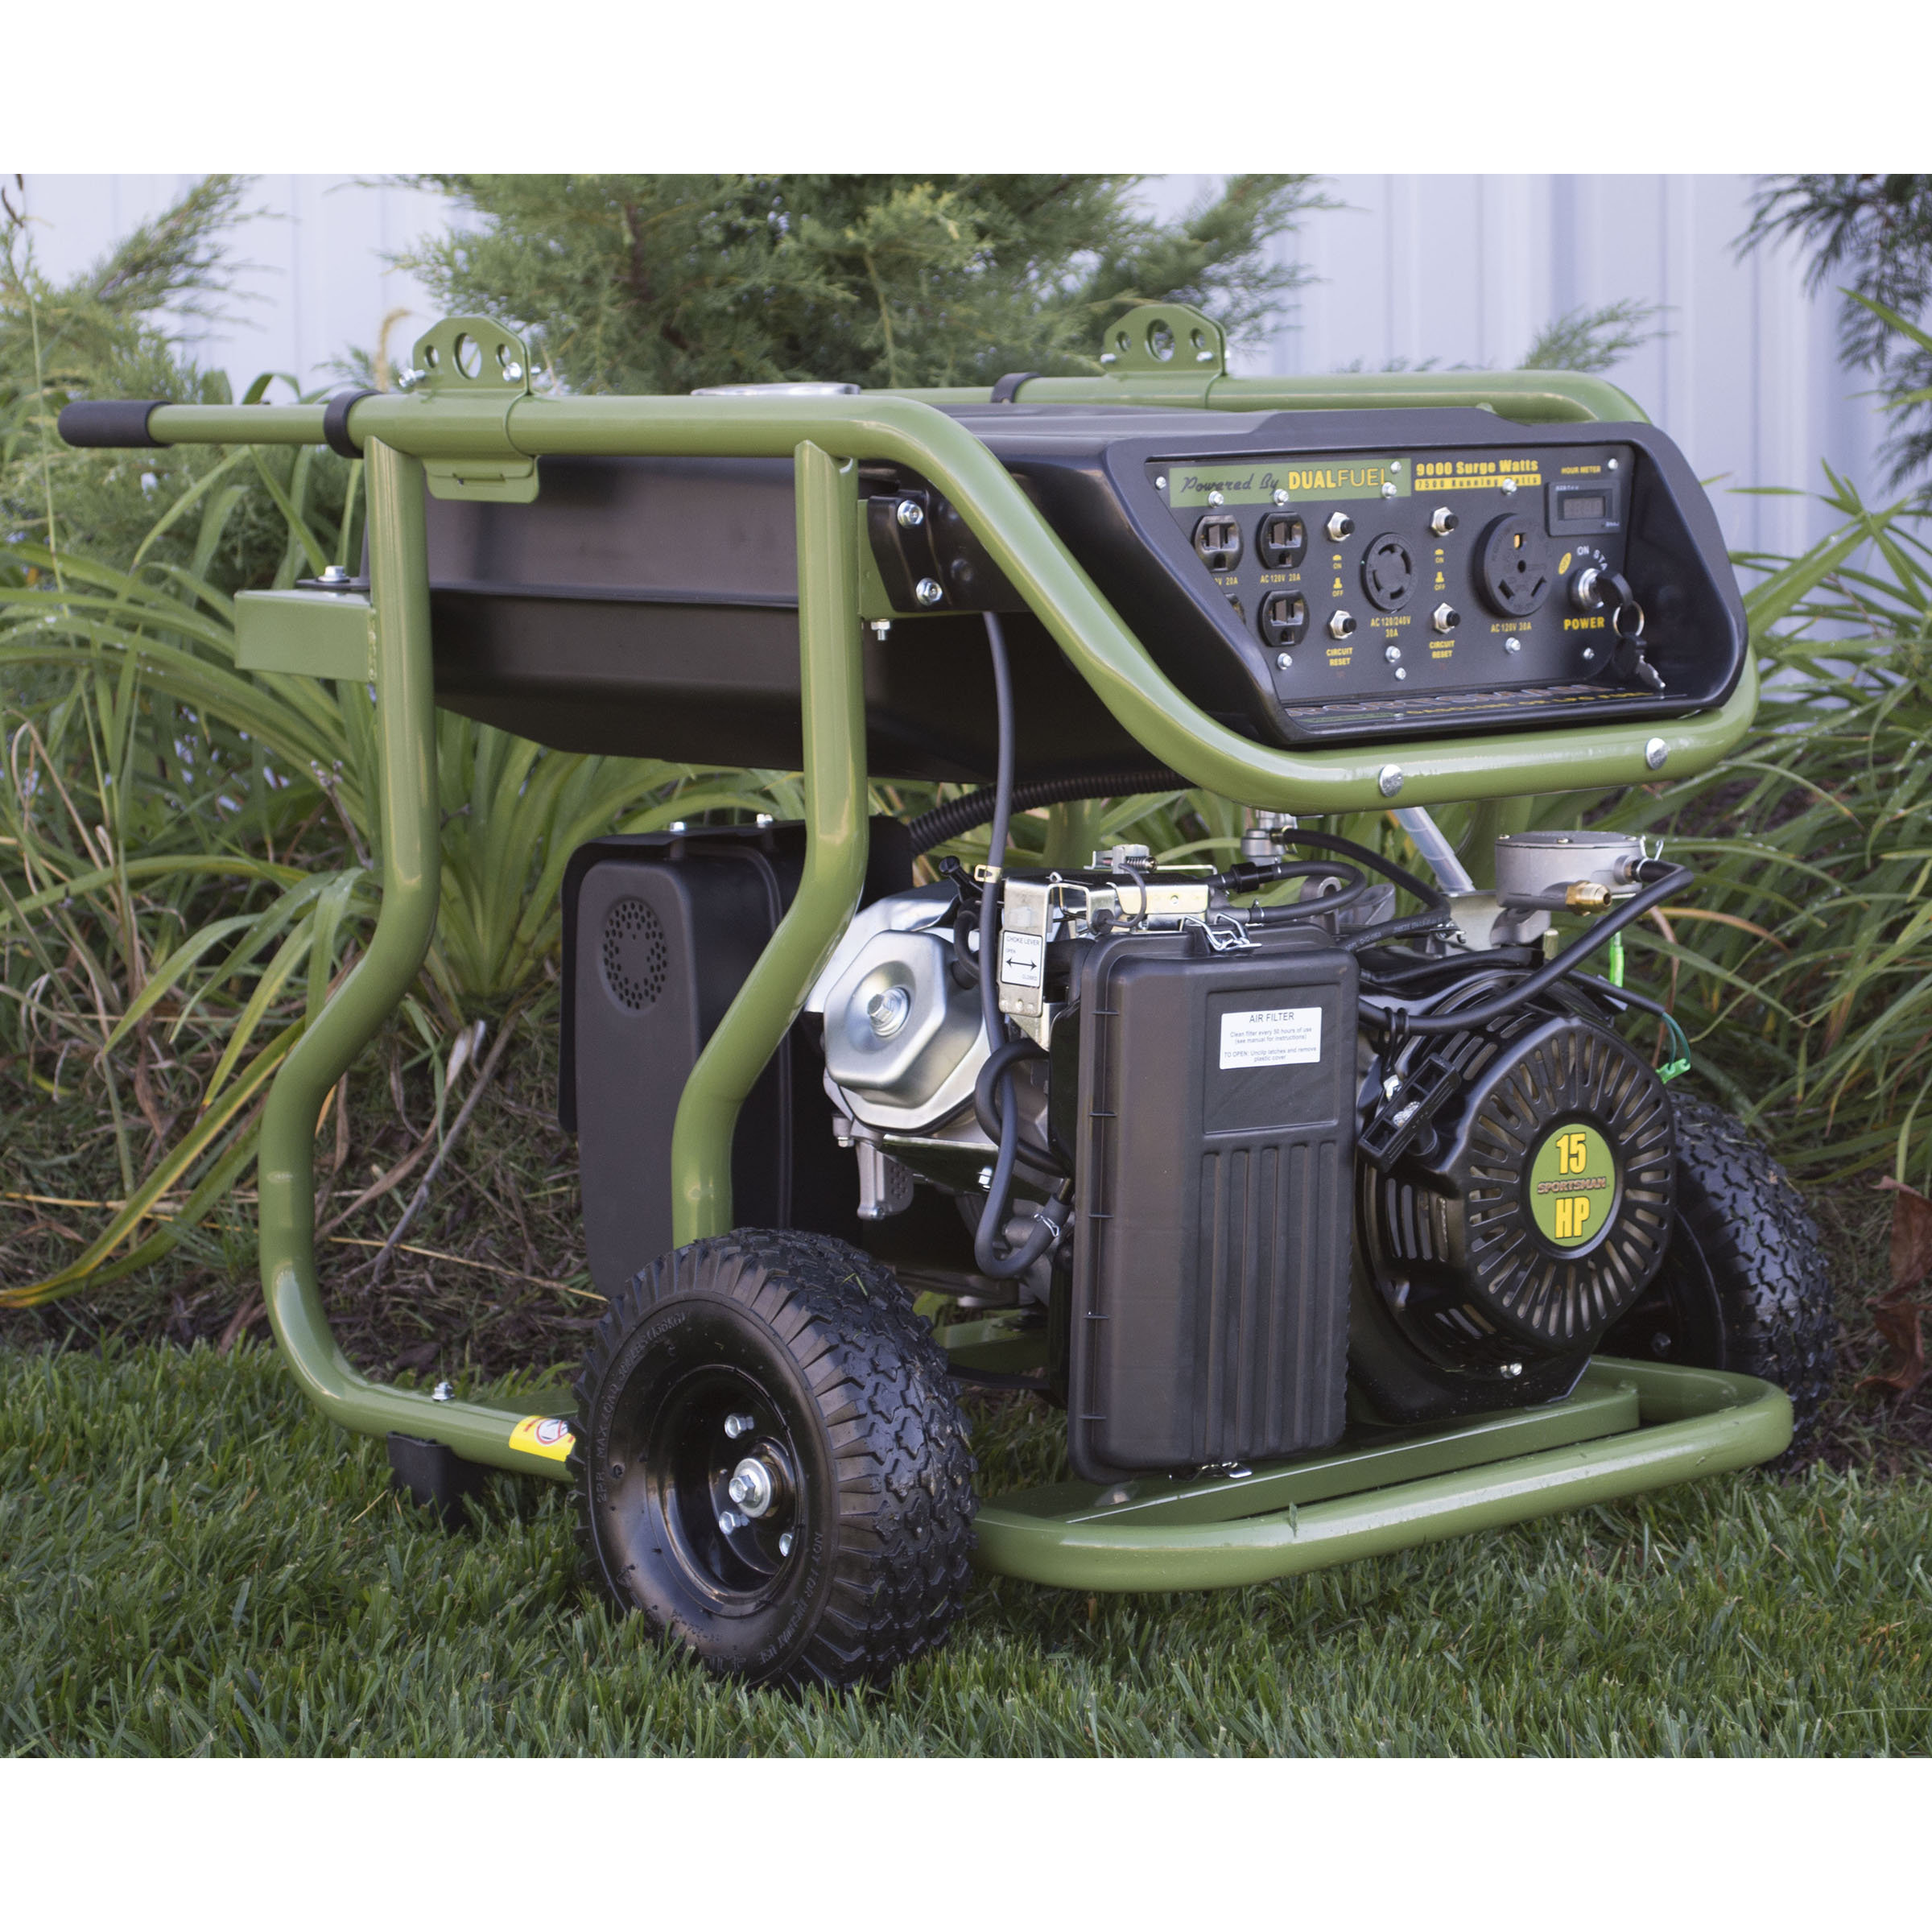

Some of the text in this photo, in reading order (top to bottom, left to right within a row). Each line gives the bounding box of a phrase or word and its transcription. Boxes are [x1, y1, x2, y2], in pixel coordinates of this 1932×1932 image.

[1416, 459, 1538, 477] 9000 Surge Watts
[1561, 465, 1601, 474] HOUR METER
[1180, 473, 1255, 493] Powered
[1260, 473, 1279, 495] By
[1577, 545, 1590, 555] ON
[1260, 574, 1269, 584] AC
[1370, 617, 1380, 627] AC
[1491, 622, 1501, 632] AC
[1563, 616, 1605, 631] POWER
[1385, 628, 1398, 638] 30A
[1429, 640, 1455, 650] CIRCUIT
[1326, 647, 1353, 657] CIRCUIT
[1431, 650, 1453, 659] RESET
[1329, 658, 1351, 667] RESET
[1024, 938, 1039, 946] LEVER
[1249, 1012, 1294, 1023] AIR FILTER
[1275, 1034, 1307, 1042] instructions)
[1250, 1049, 1267, 1057] Unclip
[1254, 1055, 1271, 1063] plastic
[1555, 1132, 1587, 1174] 15
[1537, 1176, 1607, 1195] SPORTSMAN
[1554, 1195, 1590, 1240] HP
[596, 1424, 609, 1459] MAX
[811, 1532, 824, 1562] NOT
[803, 1571, 819, 1598] FOR
